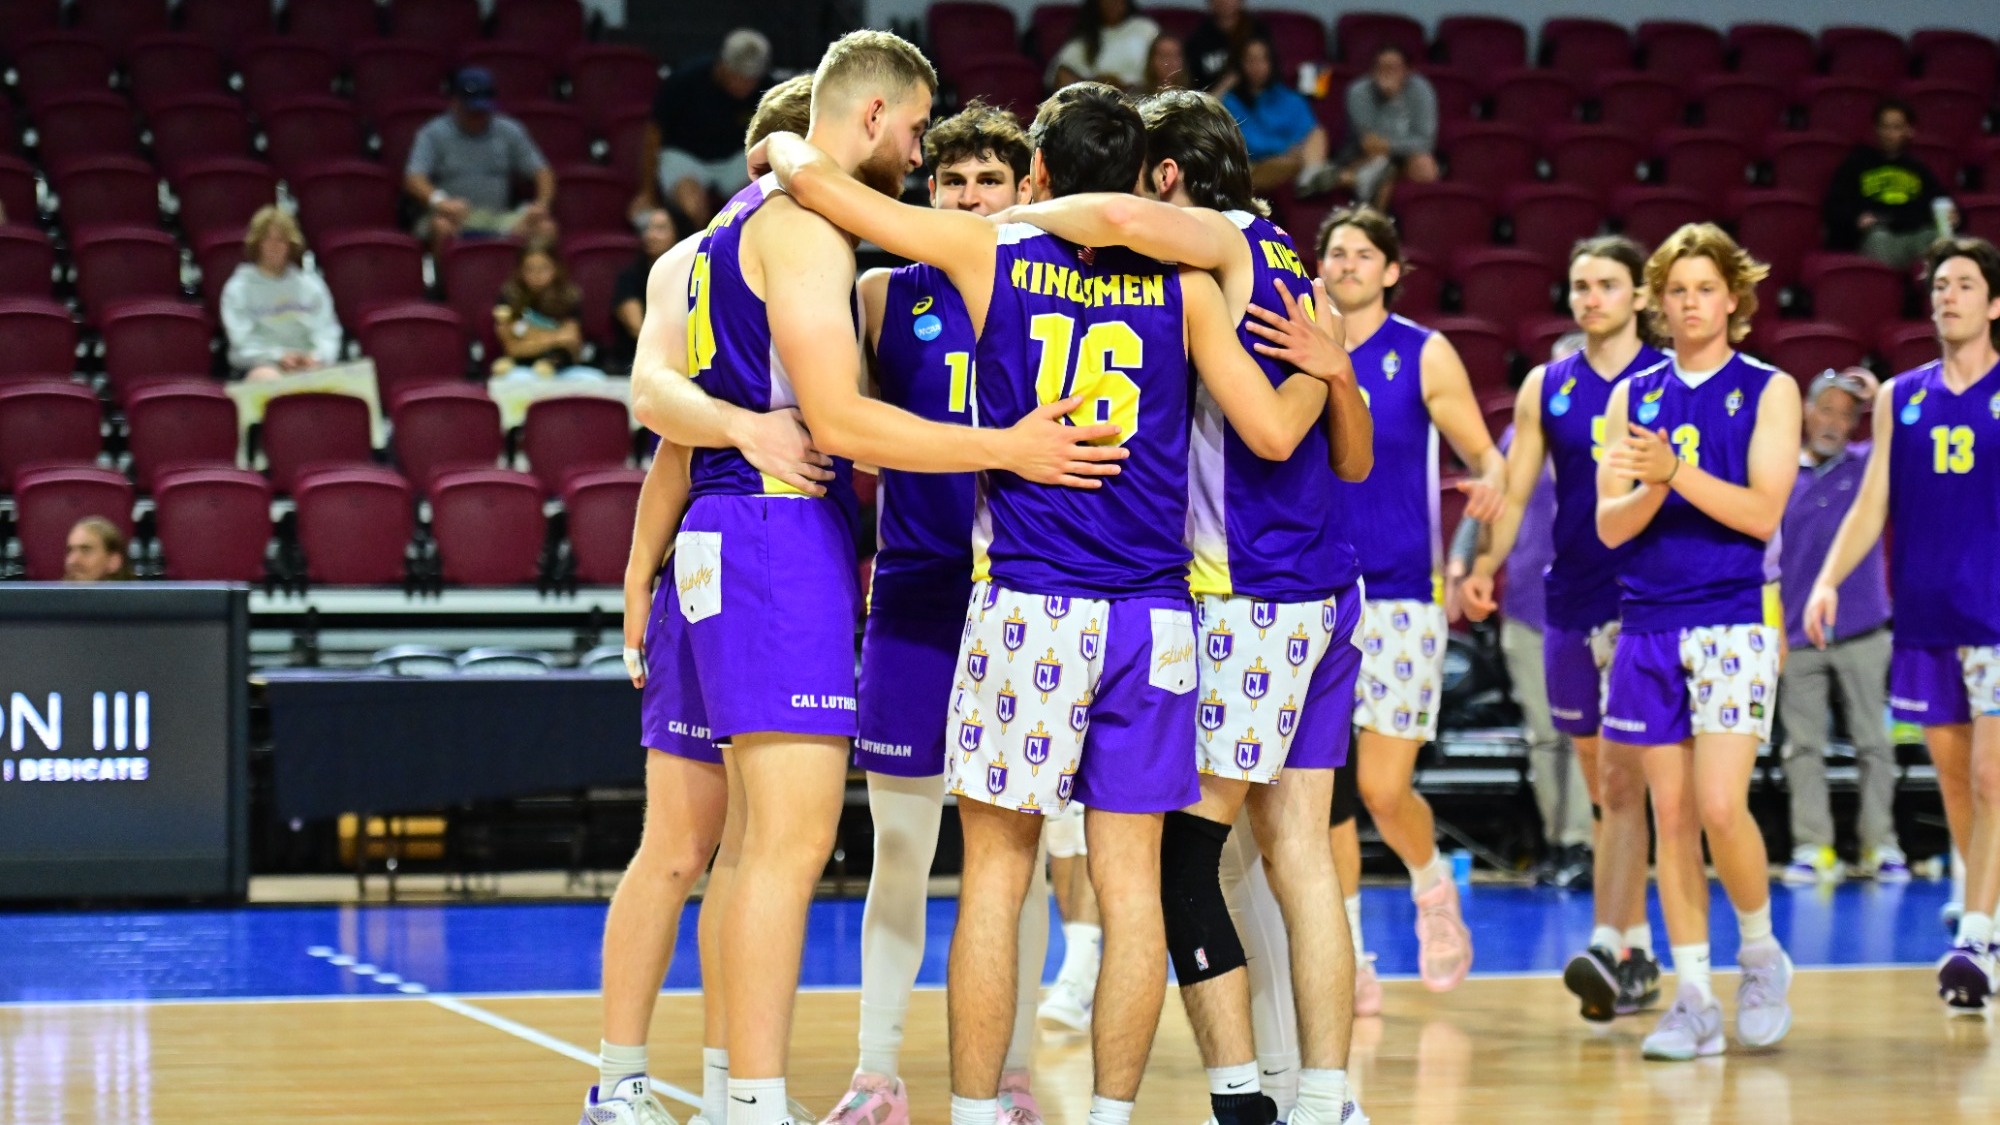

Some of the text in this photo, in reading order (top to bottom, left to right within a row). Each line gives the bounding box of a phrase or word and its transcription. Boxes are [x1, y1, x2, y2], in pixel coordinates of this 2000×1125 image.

[1011, 258, 1165, 308] KINGSMEN
[1030, 312, 1143, 447] 16
[1930, 425, 1975, 474] 13
[1006, 623, 1020, 648] CL
[1209, 635, 1227, 659] CL
[1289, 640, 1304, 664] CL
[969, 655, 981, 677] CL
[1036, 668, 1055, 691] CL
[1245, 673, 1264, 697] CL
[791, 694, 818, 708] CAL
[998, 695, 1012, 720] CL
[0, 691, 149, 751] N III
[668, 720, 688, 735] CAL
[1201, 704, 1220, 728] CL
[961, 726, 977, 749] CL
[1026, 740, 1044, 763] CL
[1237, 743, 1255, 767] CL
[19, 757, 149, 781] DEDICATE
[988, 766, 1002, 792] CL
